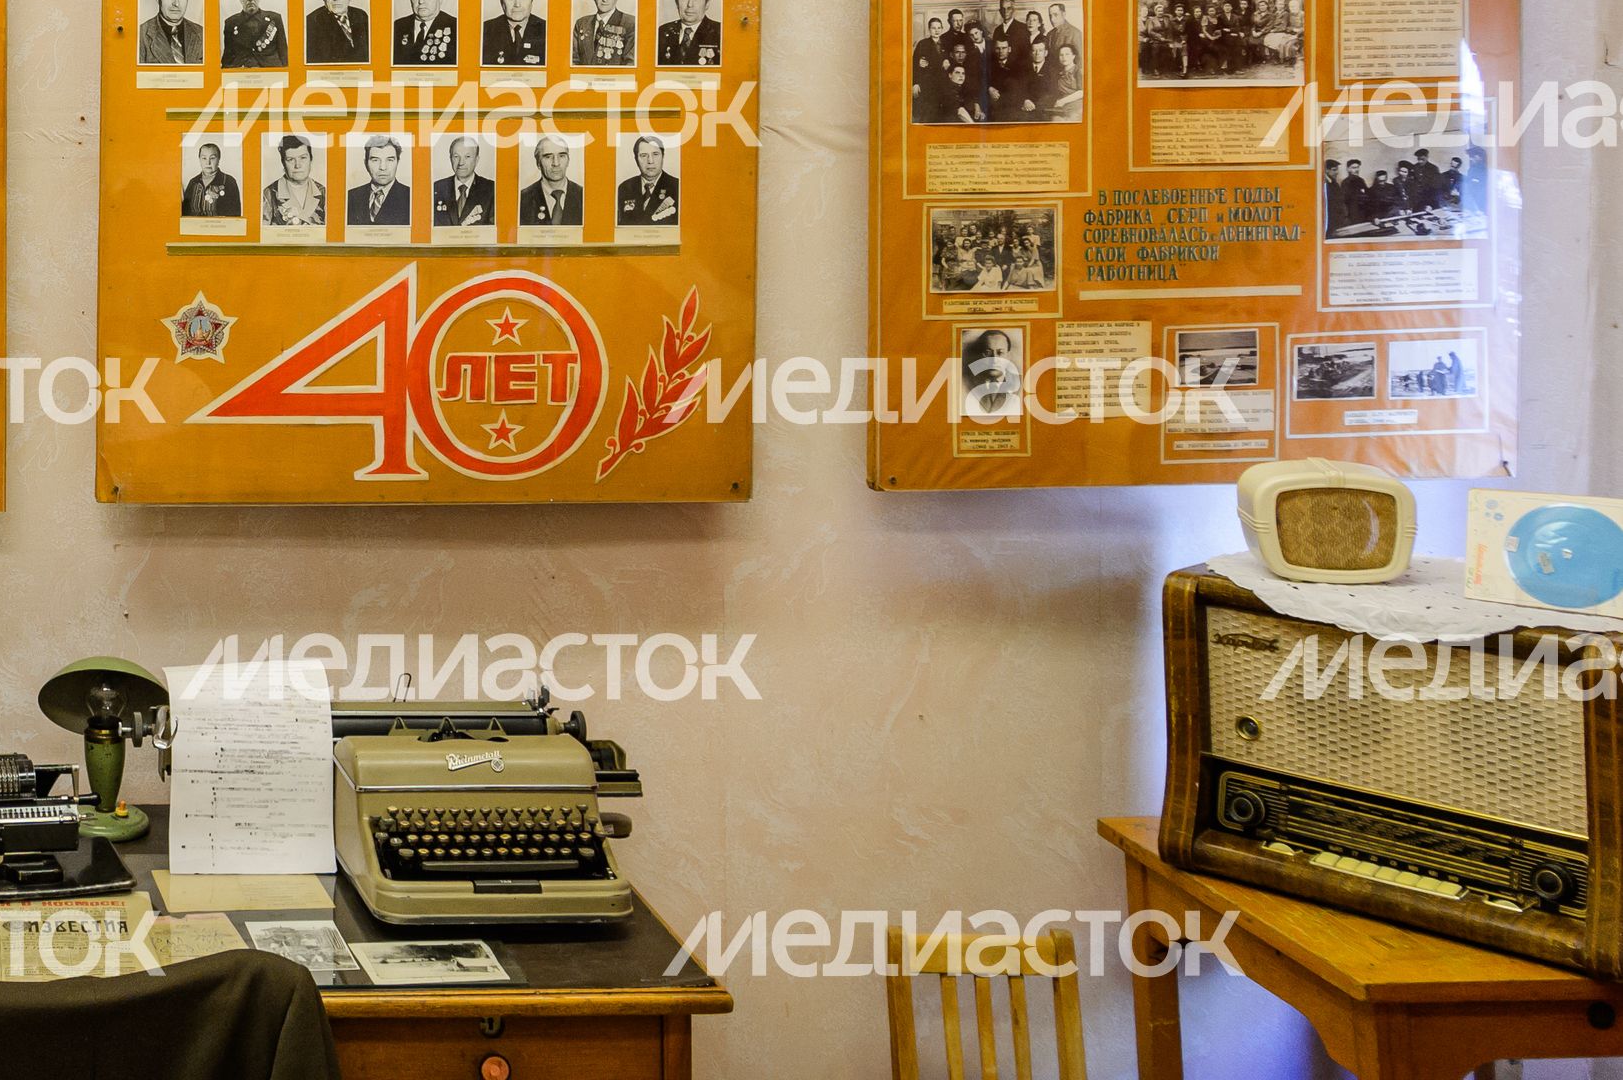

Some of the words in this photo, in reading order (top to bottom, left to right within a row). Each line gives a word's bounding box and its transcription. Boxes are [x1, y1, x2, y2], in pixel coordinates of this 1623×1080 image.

[1098, 189, 1107, 206] В
[1234, 187, 1280, 204] ГОДЫ
[1084, 209, 1153, 225] ФАБРИКА
[1083, 226, 1209, 243] СОРЕВНОВАЛАСЬ
[183, 261, 610, 482] 40
[436, 351, 579, 407] ЛЕТ
[28, 920, 129, 933] ИЗВЕСТИЯ
